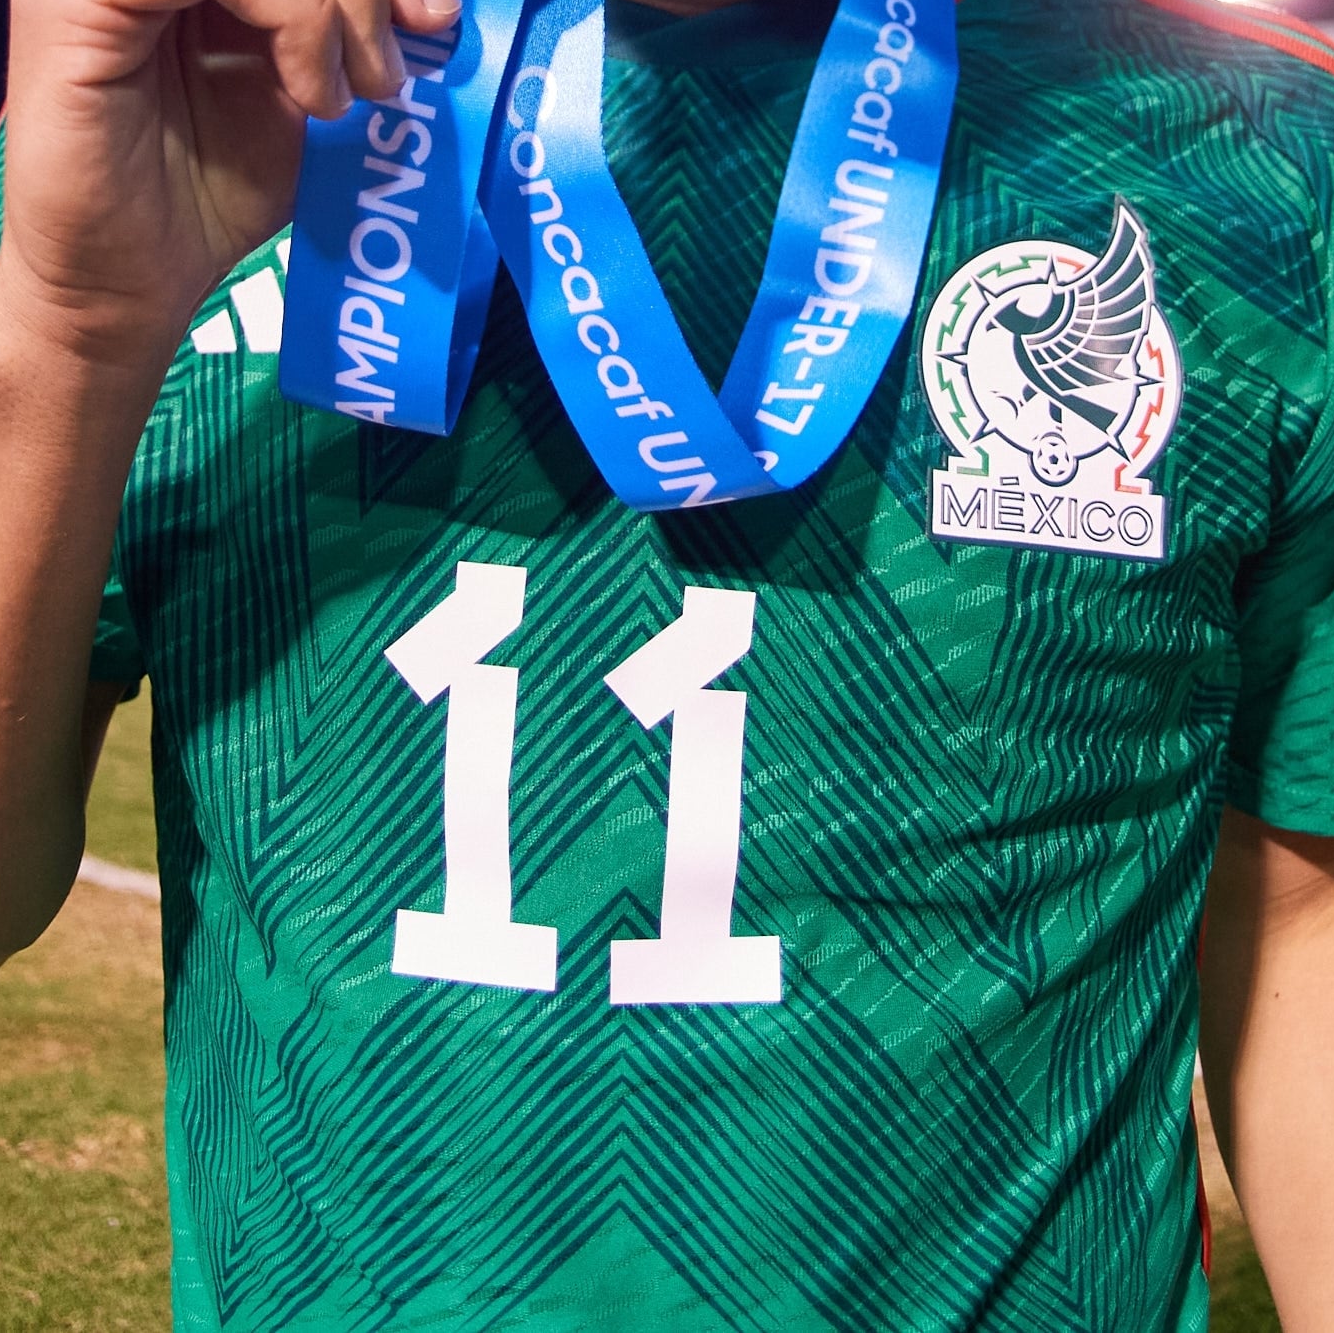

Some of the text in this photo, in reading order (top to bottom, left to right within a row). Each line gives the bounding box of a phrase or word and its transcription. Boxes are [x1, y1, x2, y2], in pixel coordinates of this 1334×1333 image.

[506, 66, 675, 420] Concacaf
[755, 159, 895, 436] UNDER-17
[940, 475, 1154, 547] MÉXICO
[384, 560, 782, 1005] 11
